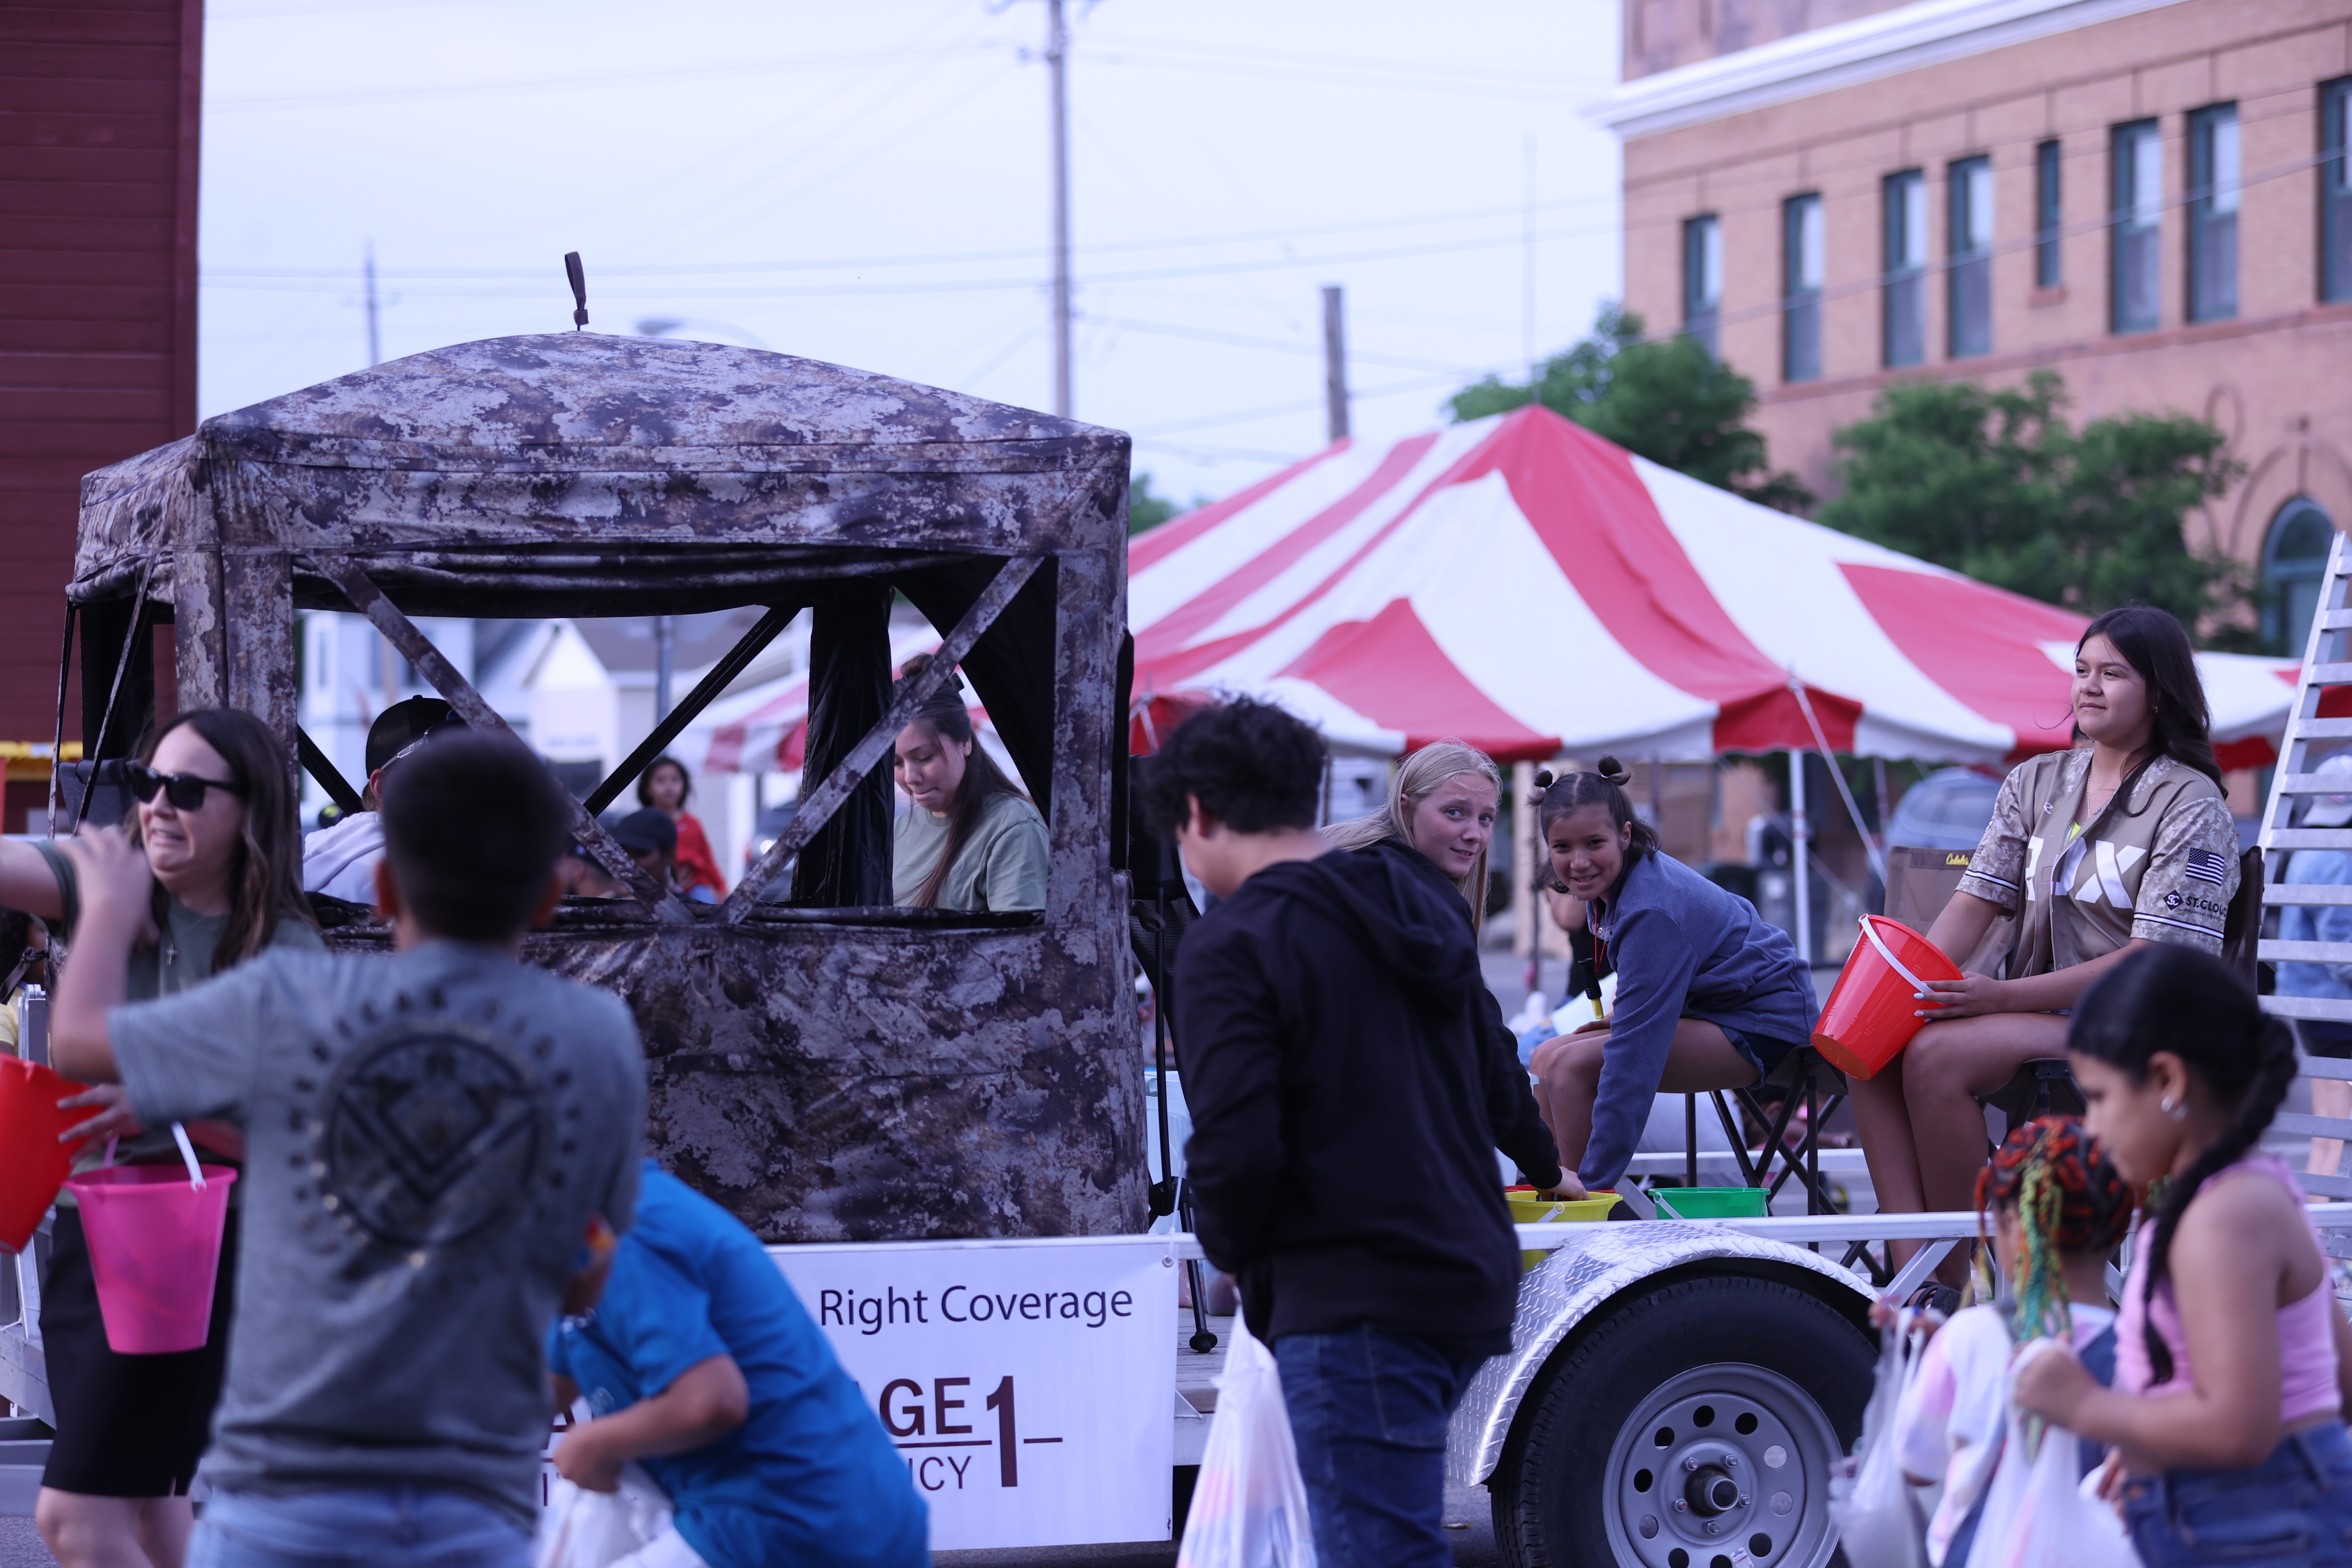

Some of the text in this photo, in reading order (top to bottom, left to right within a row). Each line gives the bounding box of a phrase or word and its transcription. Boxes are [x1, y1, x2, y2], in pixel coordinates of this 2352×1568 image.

[2184, 908, 2206, 916] FINANCIAL
[821, 1285, 1132, 1335] Right Coverage
[878, 1377, 973, 1437] GE
[911, 1455, 971, 1491] CY
